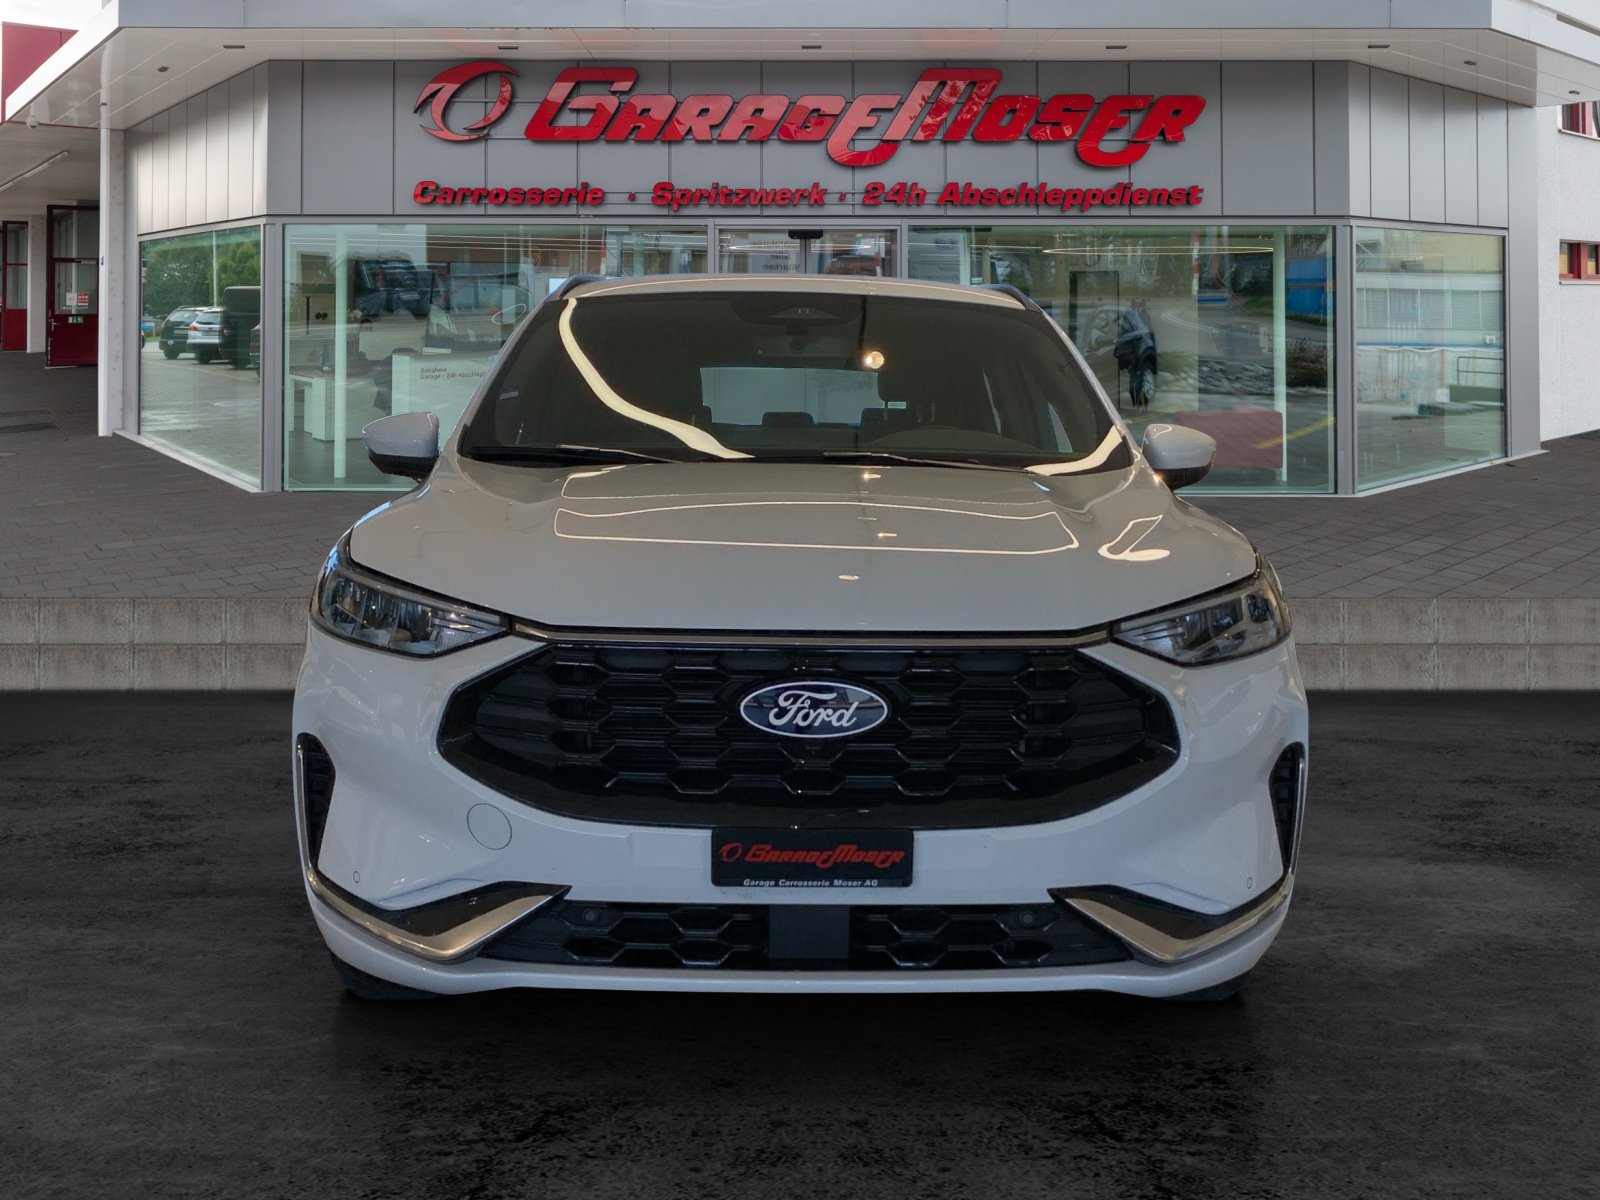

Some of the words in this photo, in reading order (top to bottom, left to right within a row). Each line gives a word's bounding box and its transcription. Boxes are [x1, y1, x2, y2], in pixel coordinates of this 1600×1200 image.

[413, 181, 605, 206] Carrosserie
[651, 181, 827, 211] Spritzwerk
[863, 181, 926, 206] 24h
[937, 181, 1204, 211] Abschleppdienst
[768, 690, 860, 727] Ford
[743, 879, 775, 887] Garage
[778, 879, 830, 887] Carrosserie
[833, 879, 862, 887] Moser
[863, 879, 878, 887] AG
